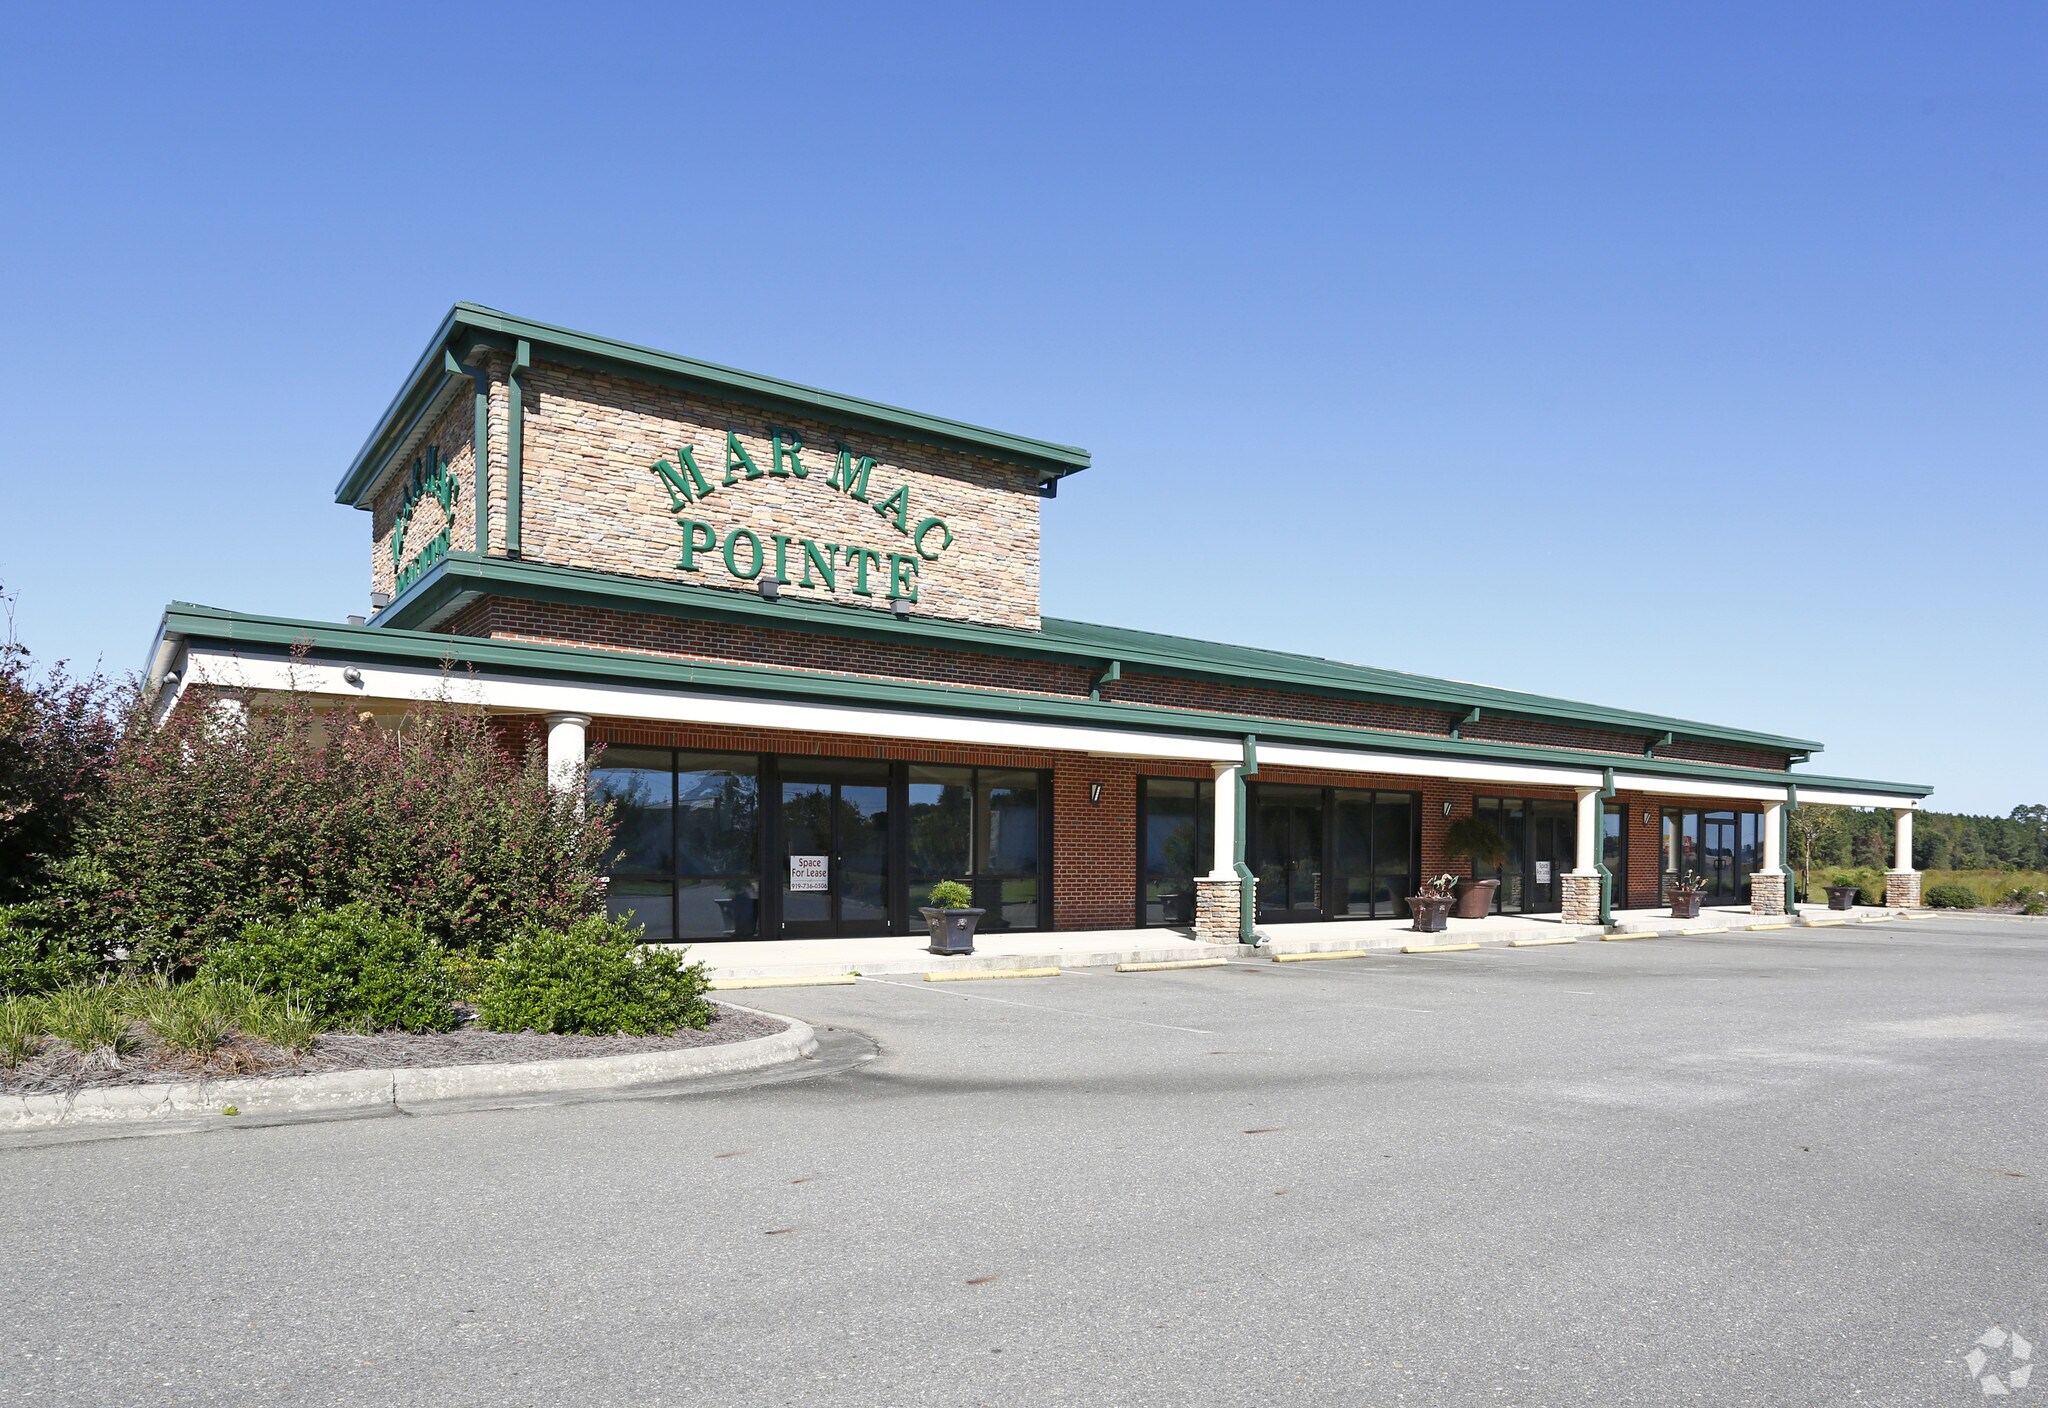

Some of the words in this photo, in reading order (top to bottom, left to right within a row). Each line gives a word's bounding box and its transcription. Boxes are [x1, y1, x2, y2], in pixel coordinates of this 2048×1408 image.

[649, 425, 808, 513] MAR
[826, 441, 954, 560] MAC
[675, 518, 918, 603] POINTE
[792, 868, 804, 877] For
[807, 868, 827, 877] Lease
[799, 858, 821, 868] Space
